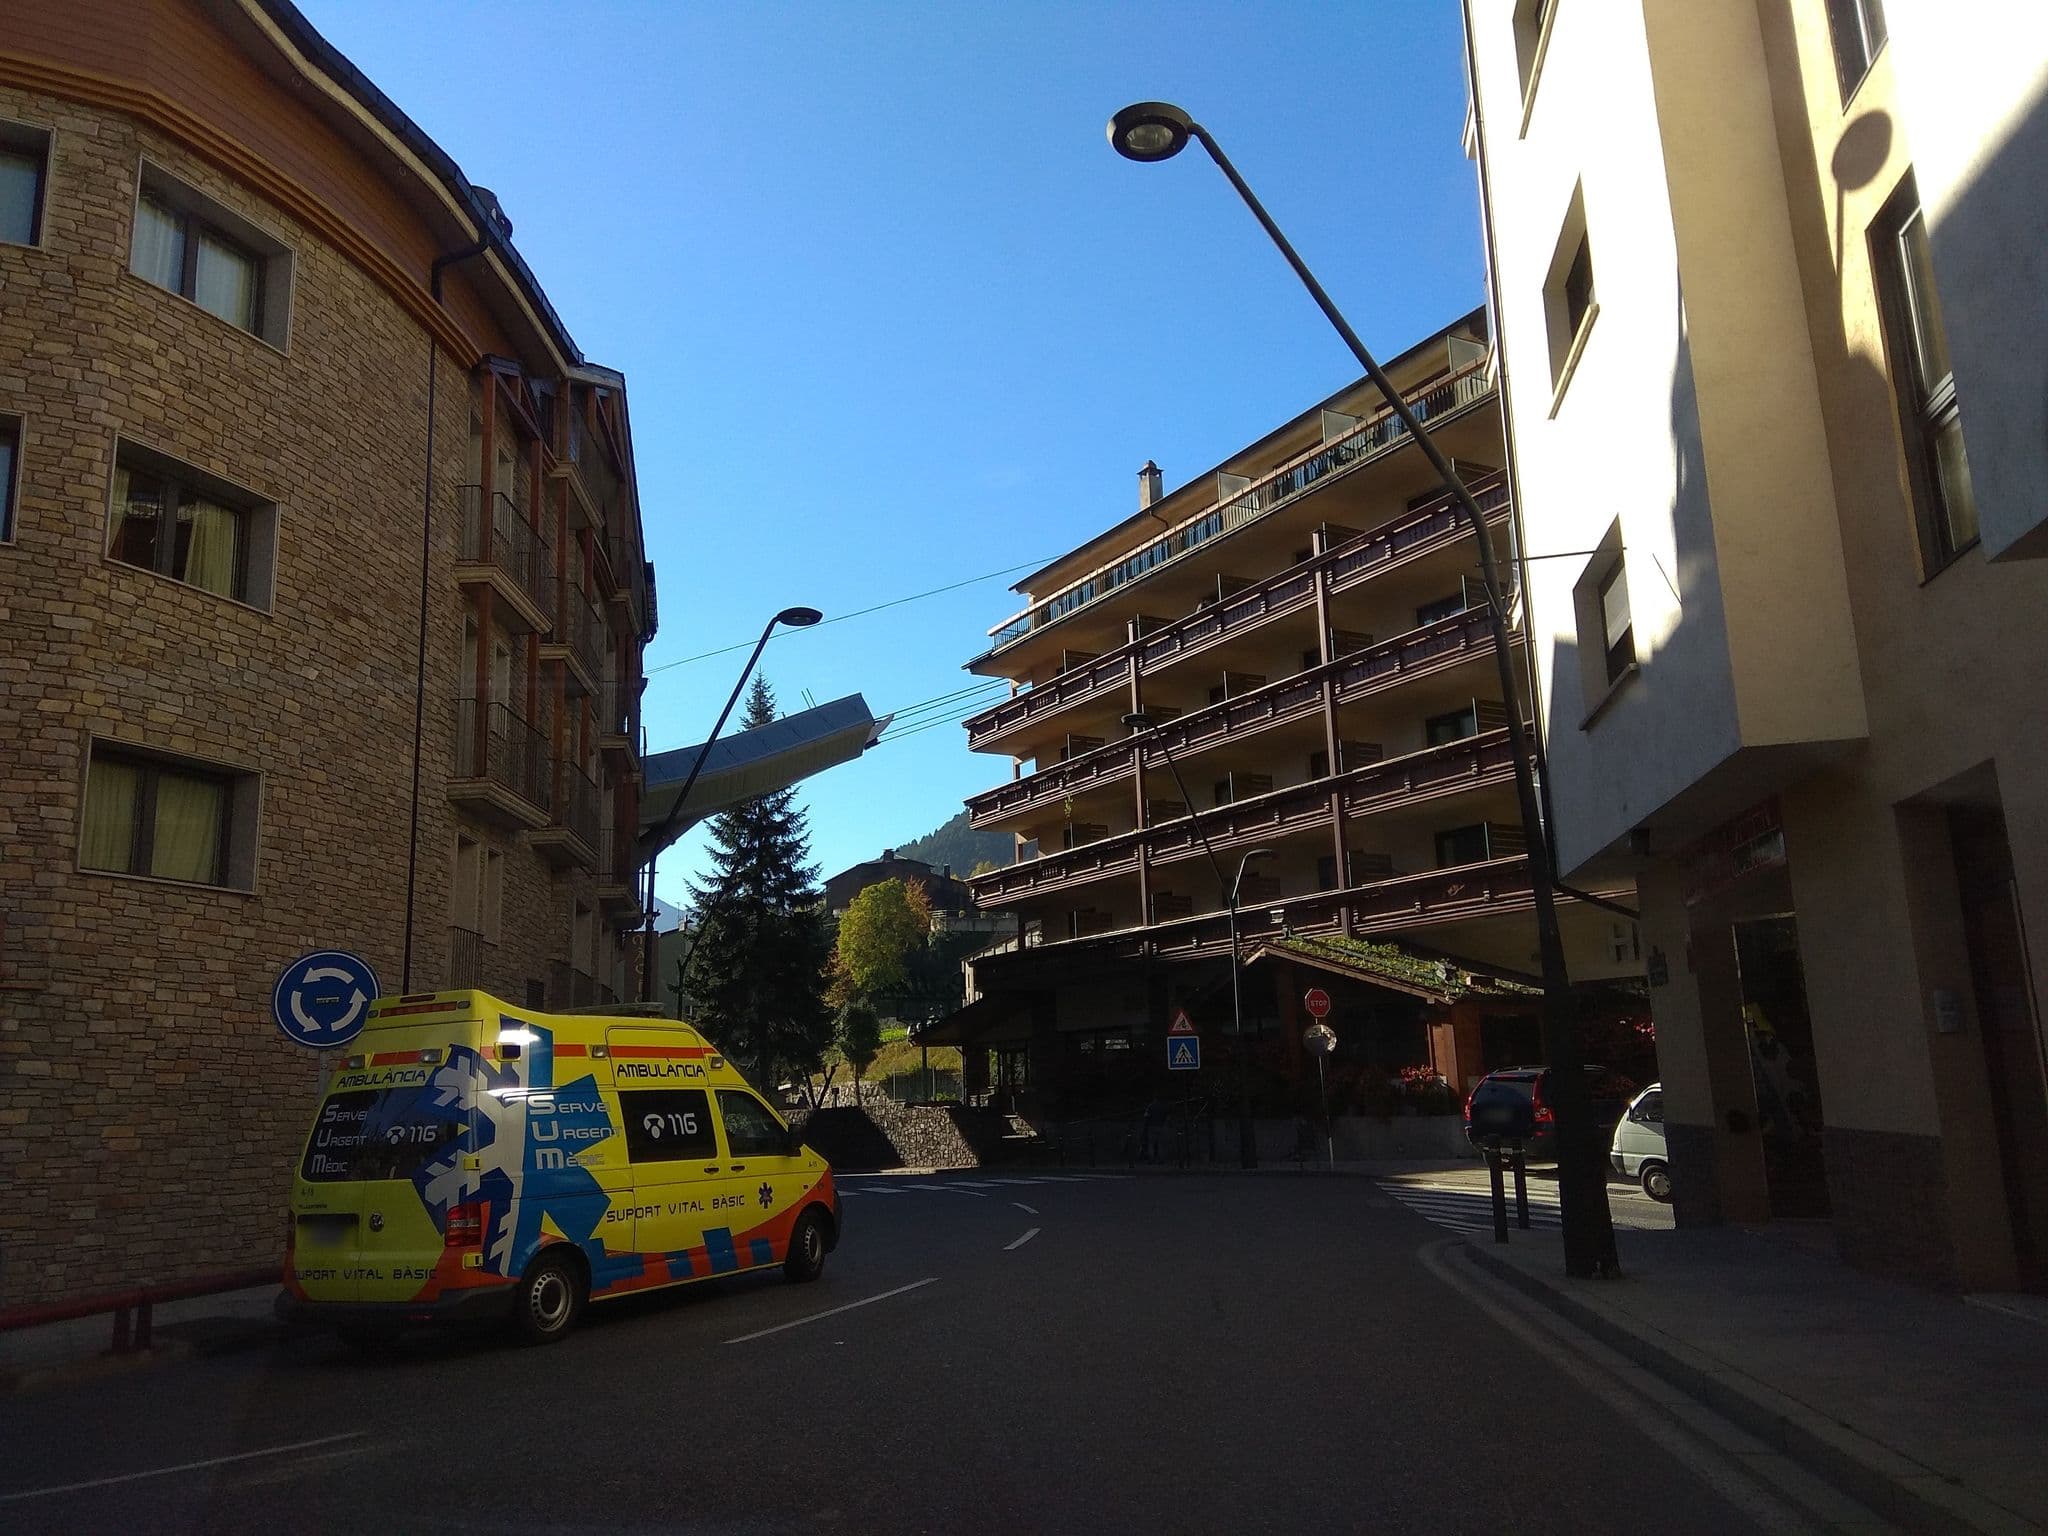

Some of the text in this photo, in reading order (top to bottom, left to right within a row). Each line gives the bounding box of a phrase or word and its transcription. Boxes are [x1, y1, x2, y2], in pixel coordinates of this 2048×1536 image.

[1309, 999, 1329, 1008] STOP
[667, 1112, 698, 1136] 116
[410, 1125, 438, 1143] 116
[606, 1205, 661, 1223] SUPORT
[668, 1201, 705, 1215] VITAL
[343, 1268, 384, 1280] VITAL
